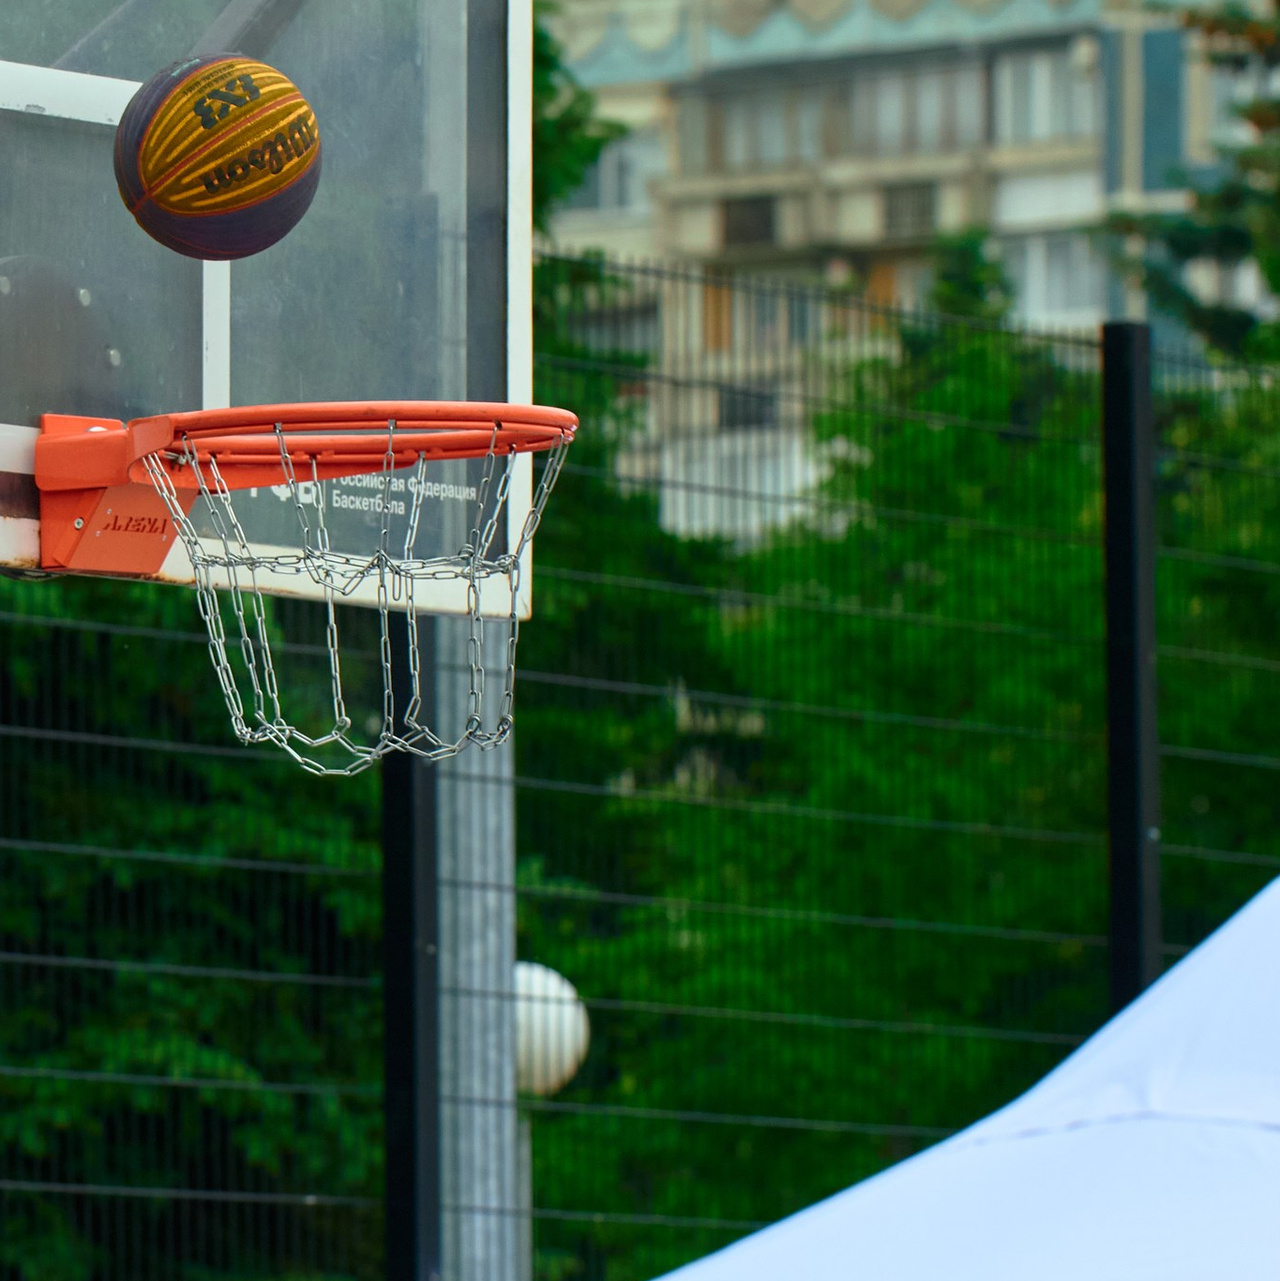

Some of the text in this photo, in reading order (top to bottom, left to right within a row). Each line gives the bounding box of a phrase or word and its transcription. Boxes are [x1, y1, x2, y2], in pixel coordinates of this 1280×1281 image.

[203, 115, 316, 195] Wilson
[332, 471, 477, 502] оссийсая Фдерация
[332, 489, 406, 515] Баскетбла
